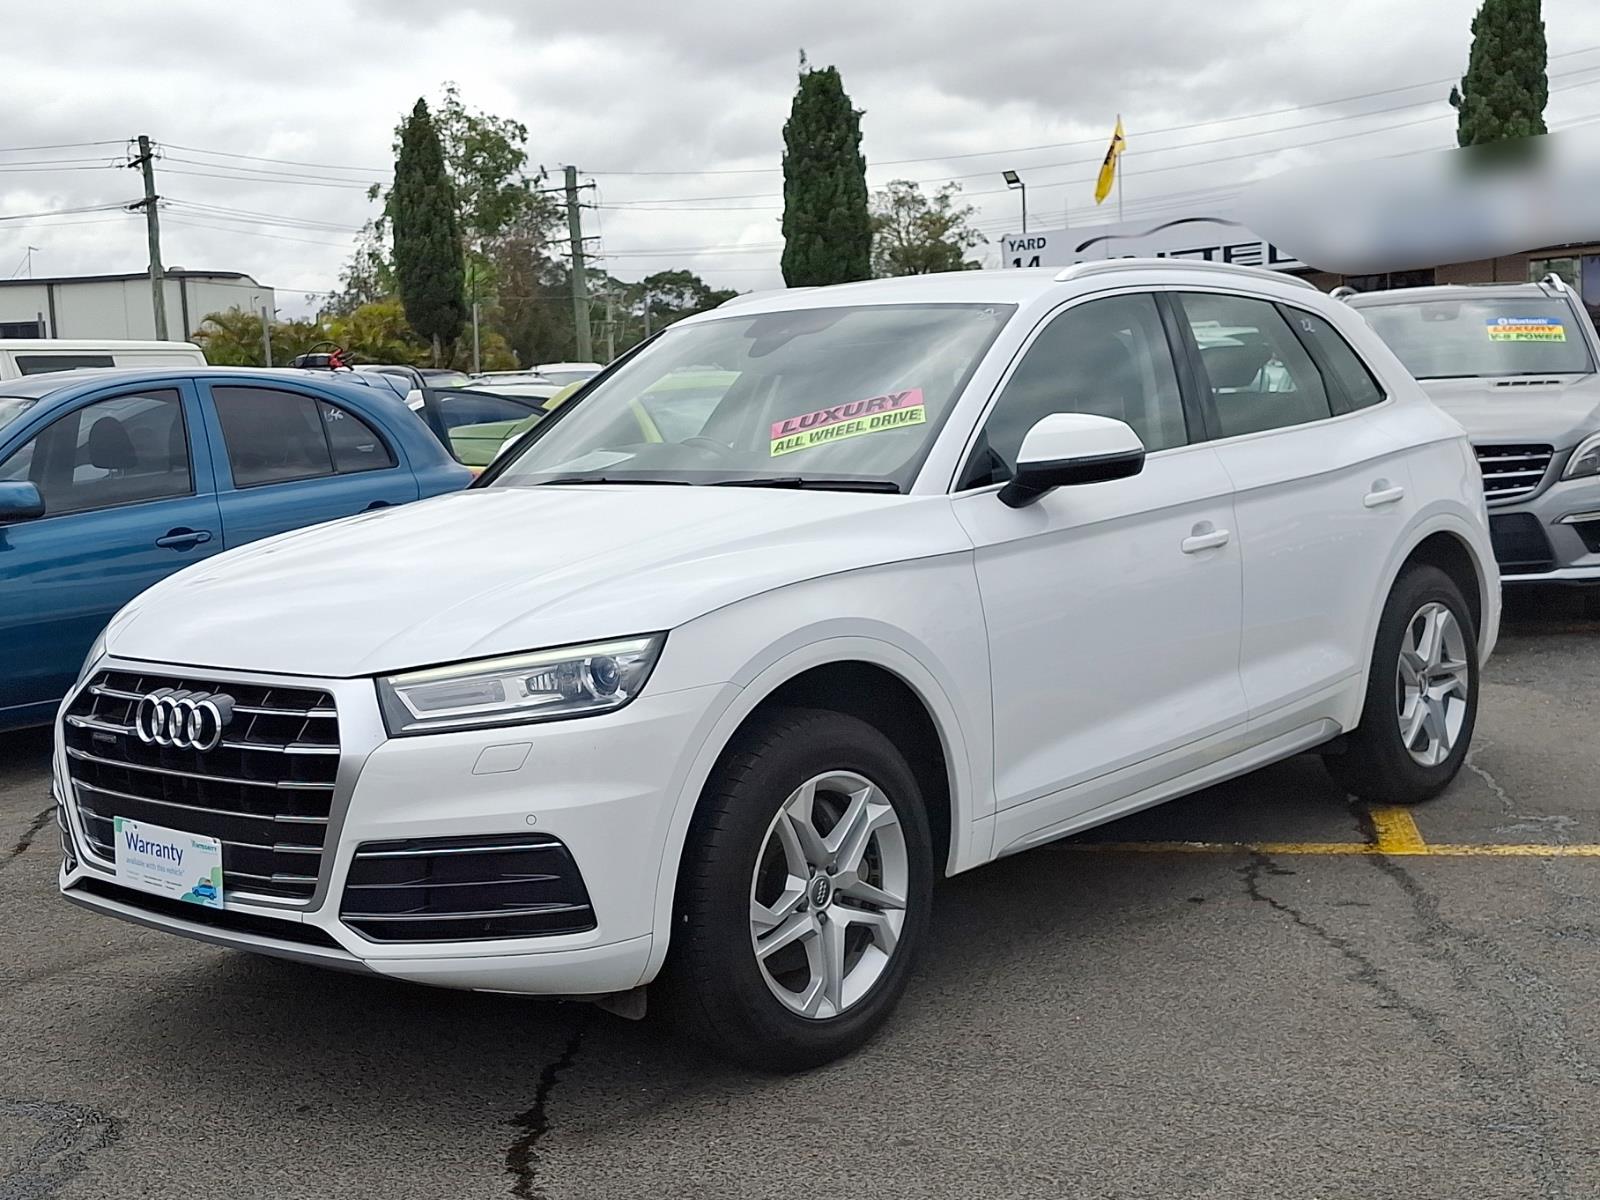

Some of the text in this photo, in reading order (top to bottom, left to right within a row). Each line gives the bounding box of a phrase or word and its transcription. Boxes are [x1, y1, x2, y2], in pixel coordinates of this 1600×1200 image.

[1008, 237, 1047, 252] YARD
[1012, 255, 1041, 268] 14
[1492, 326, 1556, 334] LUXURY
[780, 391, 912, 434] LUXURY
[772, 408, 923, 453] ALL WHEEL DRIVE
[125, 830, 184, 867] Warranty
